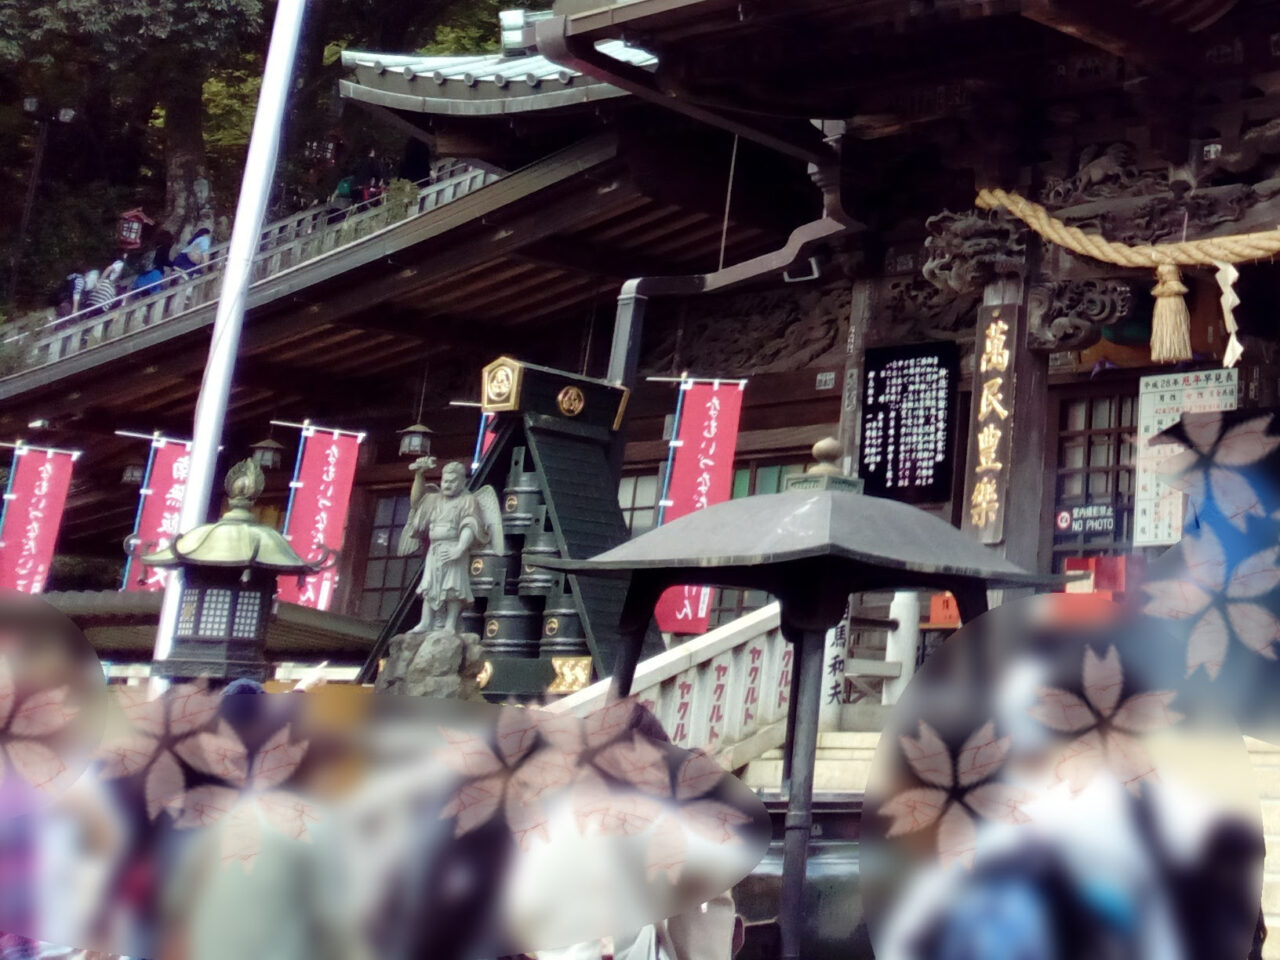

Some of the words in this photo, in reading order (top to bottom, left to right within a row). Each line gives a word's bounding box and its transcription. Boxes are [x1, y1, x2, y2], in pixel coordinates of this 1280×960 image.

[1072, 520, 1083, 531] NO
[1086, 518, 1113, 531] PHOTO
[743, 646, 762, 725] ヤクルト
[777, 642, 794, 709] クルト
[825, 607, 850, 705] 馬和夫
[673, 680, 692, 741] ヤクル
[709, 663, 728, 742] ヤクルト
